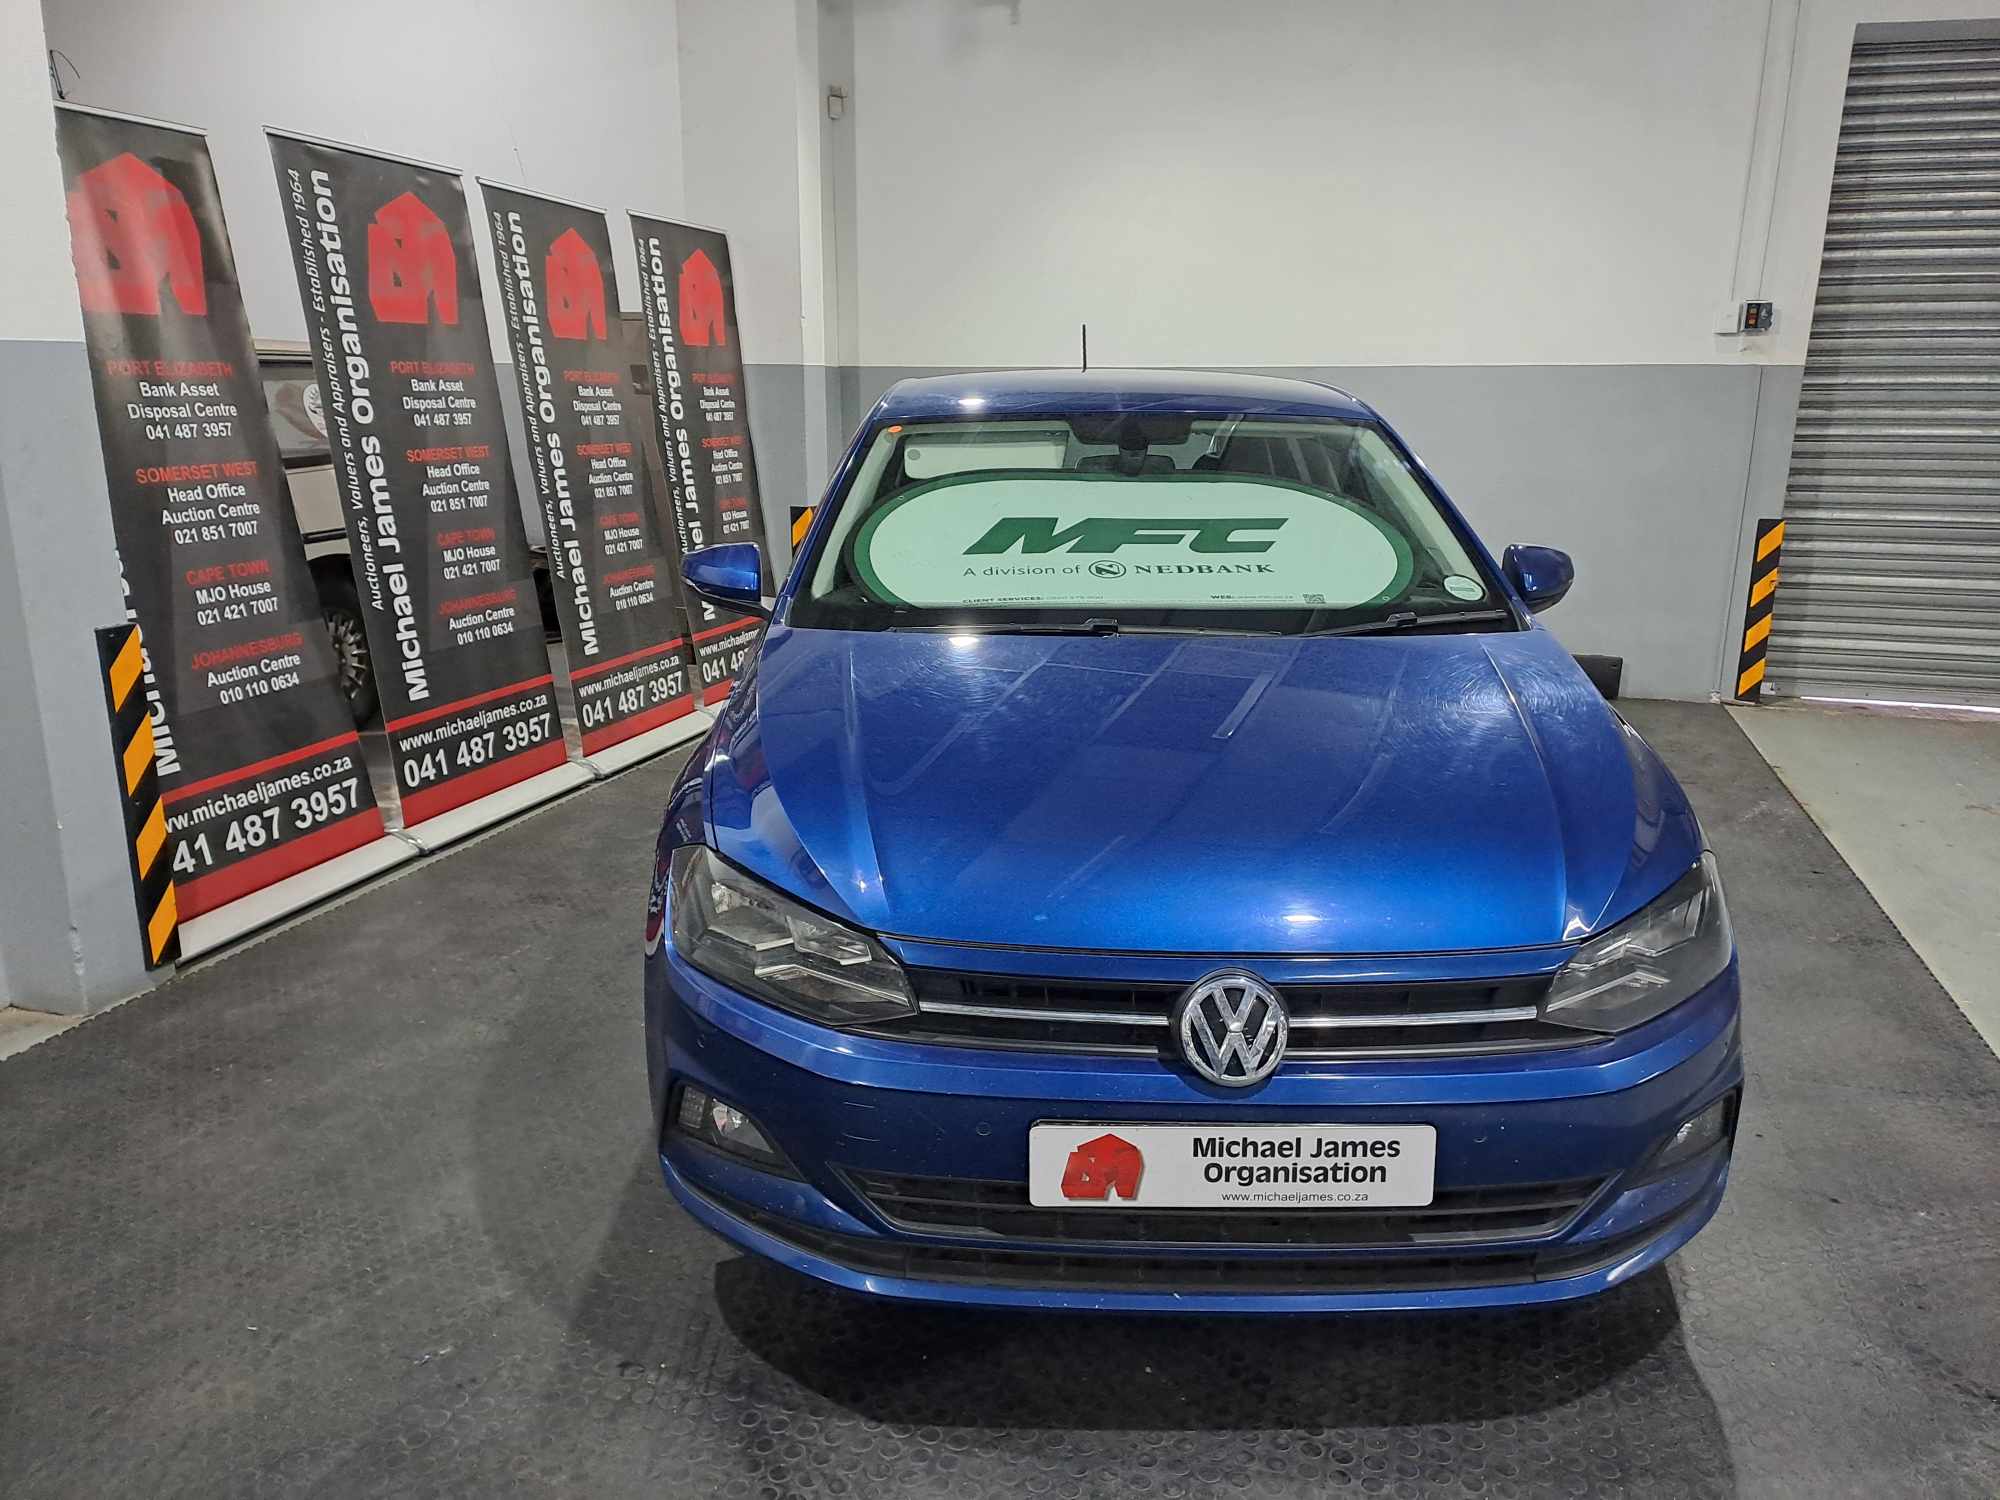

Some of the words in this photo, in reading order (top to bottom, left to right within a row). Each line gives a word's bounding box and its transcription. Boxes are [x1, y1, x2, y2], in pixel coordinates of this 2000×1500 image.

[288, 168, 307, 211] 1964
[295, 213, 326, 313] Established
[310, 169, 375, 425] Organisation
[507, 211, 556, 424] Organisation
[648, 237, 684, 421] Organisation
[319, 326, 346, 413] Appraisers
[139, 382, 177, 397] Bank
[180, 382, 220, 397] Asset
[411, 379, 437, 392] Bank
[439, 379, 464, 392] Asset
[127, 403, 191, 422] Disposal
[194, 402, 238, 418] Centre
[402, 396, 447, 412] Disposal
[447, 396, 477, 409] Centre
[145, 425, 171, 440] 041
[174, 424, 198, 439] 487
[202, 422, 232, 437] 3957
[335, 415, 352, 447] and
[413, 413, 431, 427] 041
[433, 413, 450, 426] 487
[452, 412, 472, 426] 3957
[527, 416, 540, 443] and
[135, 464, 220, 484] SOMERSET
[223, 461, 258, 476] WEST
[343, 451, 364, 510] Valuers
[426, 465, 452, 479] Head
[453, 463, 480, 476] Office
[534, 445, 550, 494] Valuers
[546, 432, 576, 532] James
[675, 428, 699, 513] James
[167, 487, 203, 503] Head
[206, 483, 247, 498] Office
[361, 435, 401, 554] James
[422, 482, 460, 497] Auction
[461, 480, 490, 493] Centre
[162, 507, 216, 525] Auction
[218, 502, 261, 519] Centre
[430, 500, 447, 513] 021
[448, 498, 466, 511] 851
[468, 495, 488, 508] 7007
[174, 528, 199, 544] 021
[201, 524, 226, 541] 851
[229, 521, 258, 537] 7007
[961, 517, 1289, 555] MFC
[357, 516, 385, 610] Auctioneers,
[443, 548, 465, 563] MJO
[466, 546, 496, 559] House
[185, 568, 225, 586] CAPE
[443, 566, 460, 580] 021
[462, 563, 479, 577] 421
[480, 559, 501, 573] 7007
[963, 566, 976, 577] A
[984, 563, 1057, 577] division
[1062, 563, 1081, 576] of
[1134, 562, 1276, 575] NEDBANK
[195, 587, 226, 605] MJO
[229, 581, 272, 598] House
[563, 539, 600, 656] Michael
[197, 610, 221, 626] 021
[223, 604, 248, 621] 421
[250, 597, 279, 616] 7007
[449, 614, 484, 631] Auction
[485, 607, 516, 621] Centre
[382, 563, 431, 702] Michael
[457, 631, 474, 646] 010
[475, 626, 491, 641] 110
[492, 621, 515, 637] 0634
[207, 664, 258, 688] Auction
[260, 653, 302, 674] Centre
[578, 655, 680, 699] www.michaeljames.co.za
[702, 656, 727, 683] 041
[219, 686, 244, 705] 010
[245, 680, 269, 699] 110
[271, 672, 301, 691] 0634
[582, 696, 613, 728] 041
[618, 684, 645, 714] 487
[649, 671, 683, 703] 3957
[399, 694, 549, 753] www.michaeljames.co.za
[403, 748, 449, 788] 041
[456, 731, 495, 768] 487
[502, 712, 551, 752] 3957
[225, 806, 281, 853] 487
[290, 777, 360, 831] 3957
[1191, 1135, 1302, 1159] Michael
[1310, 1136, 1401, 1159] James
[1203, 1161, 1388, 1187] Organisation
[1221, 1191, 1369, 1203] www.michaeljames.co.za
